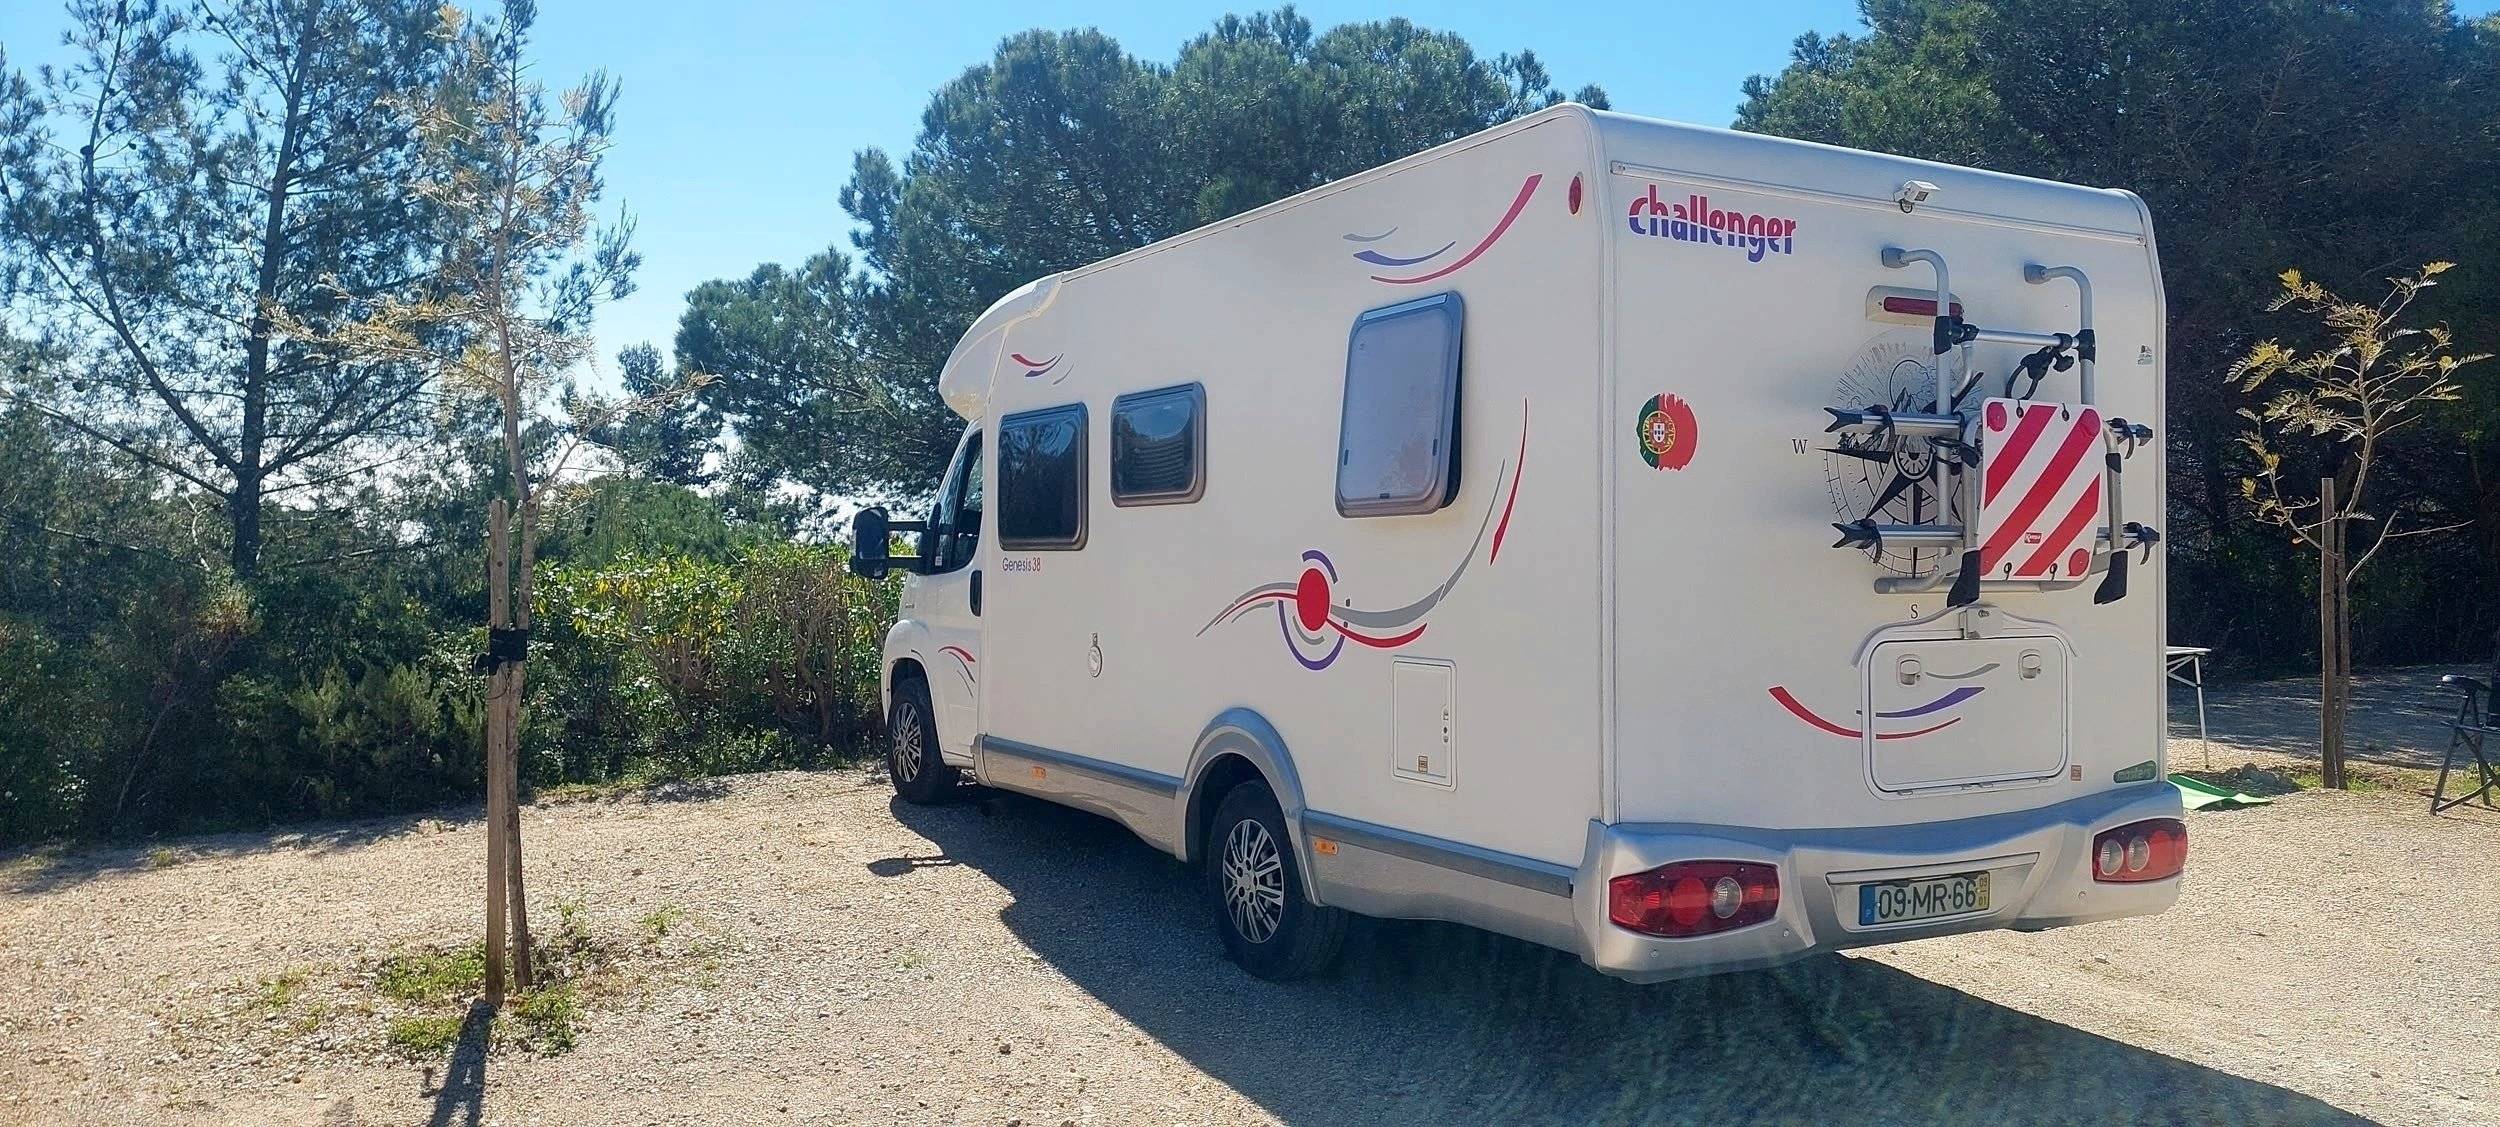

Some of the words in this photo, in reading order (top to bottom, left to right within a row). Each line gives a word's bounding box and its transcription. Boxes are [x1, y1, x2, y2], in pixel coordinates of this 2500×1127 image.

[1628, 183, 1797, 263] challenger
[1791, 438, 1808, 455] W
[1002, 556, 1031, 571] Genesis
[1032, 556, 1041, 571] 38
[1910, 603, 1919, 619] S
